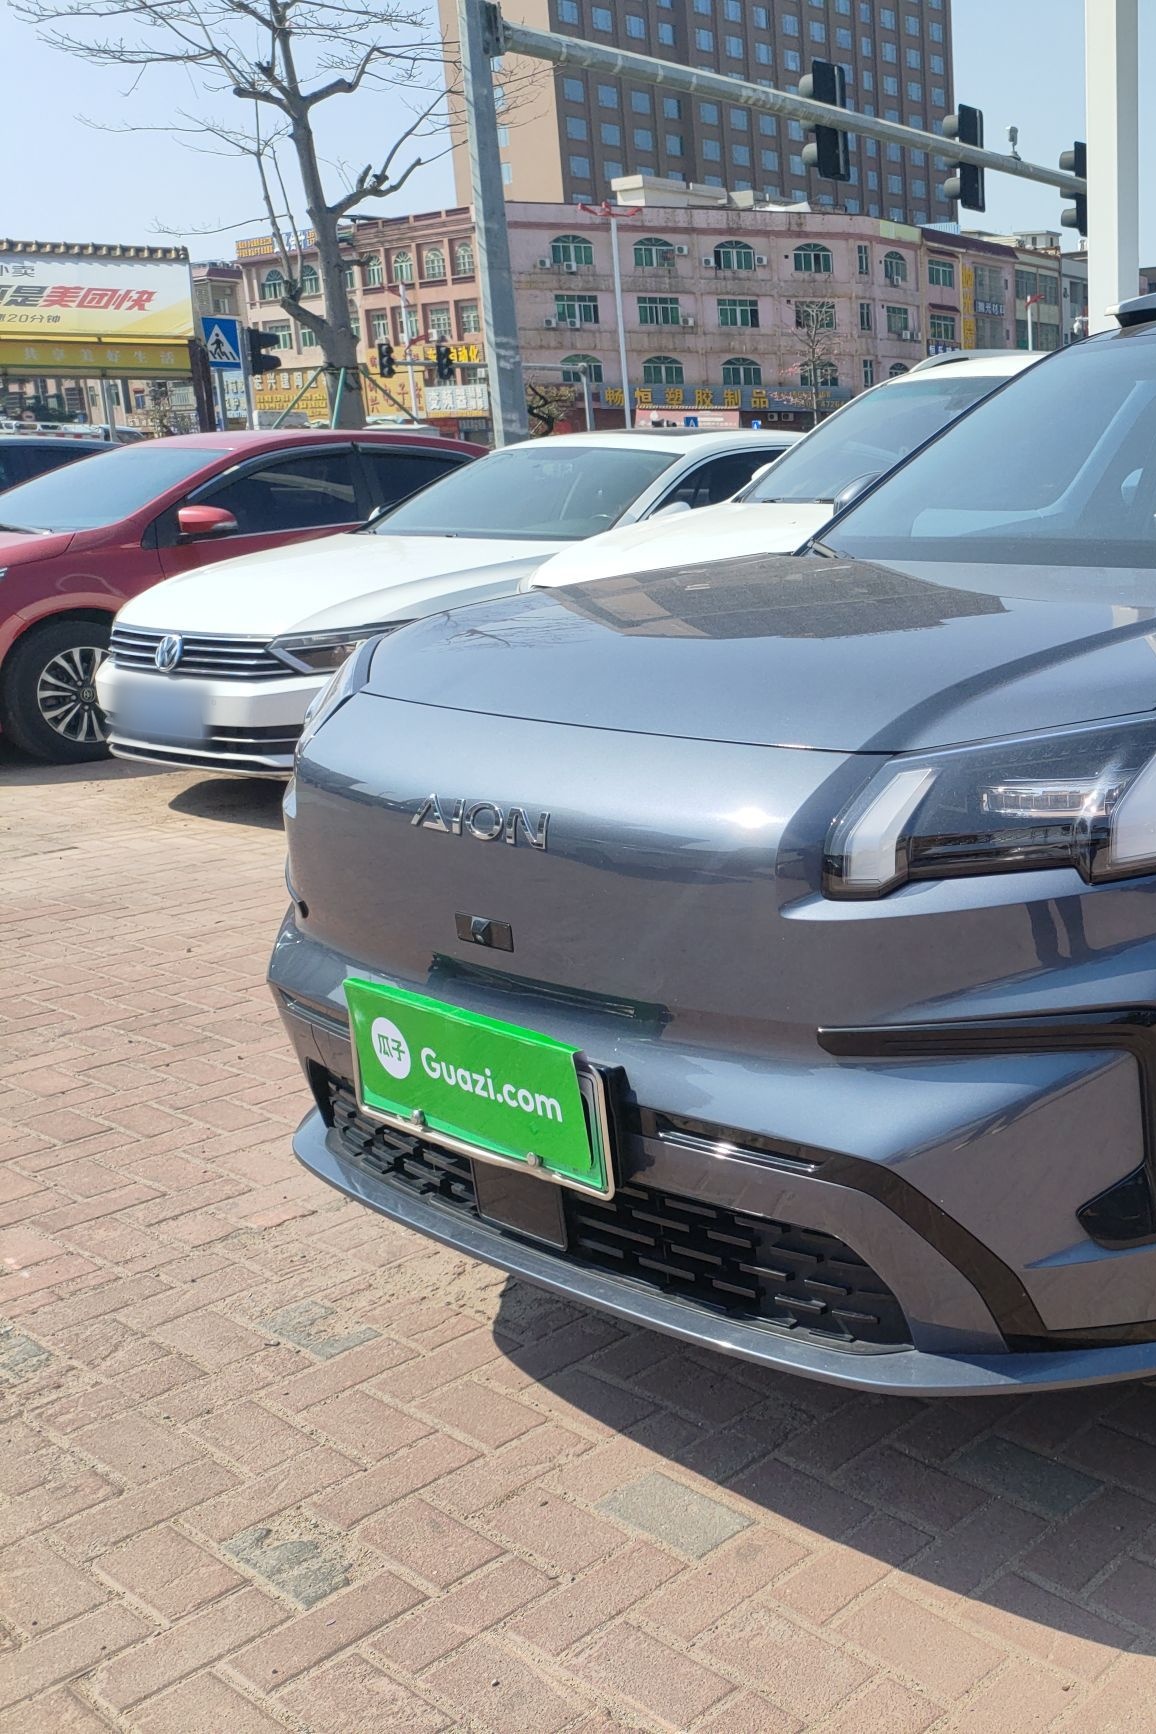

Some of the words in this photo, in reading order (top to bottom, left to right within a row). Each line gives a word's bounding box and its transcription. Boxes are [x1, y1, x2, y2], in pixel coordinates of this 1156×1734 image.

[605, 387, 769, 409] 畅恒塑胶制品
[411, 793, 551, 850] AION
[377, 1033, 406, 1062] 瓜子
[420, 1047, 563, 1123] Guazi.com
